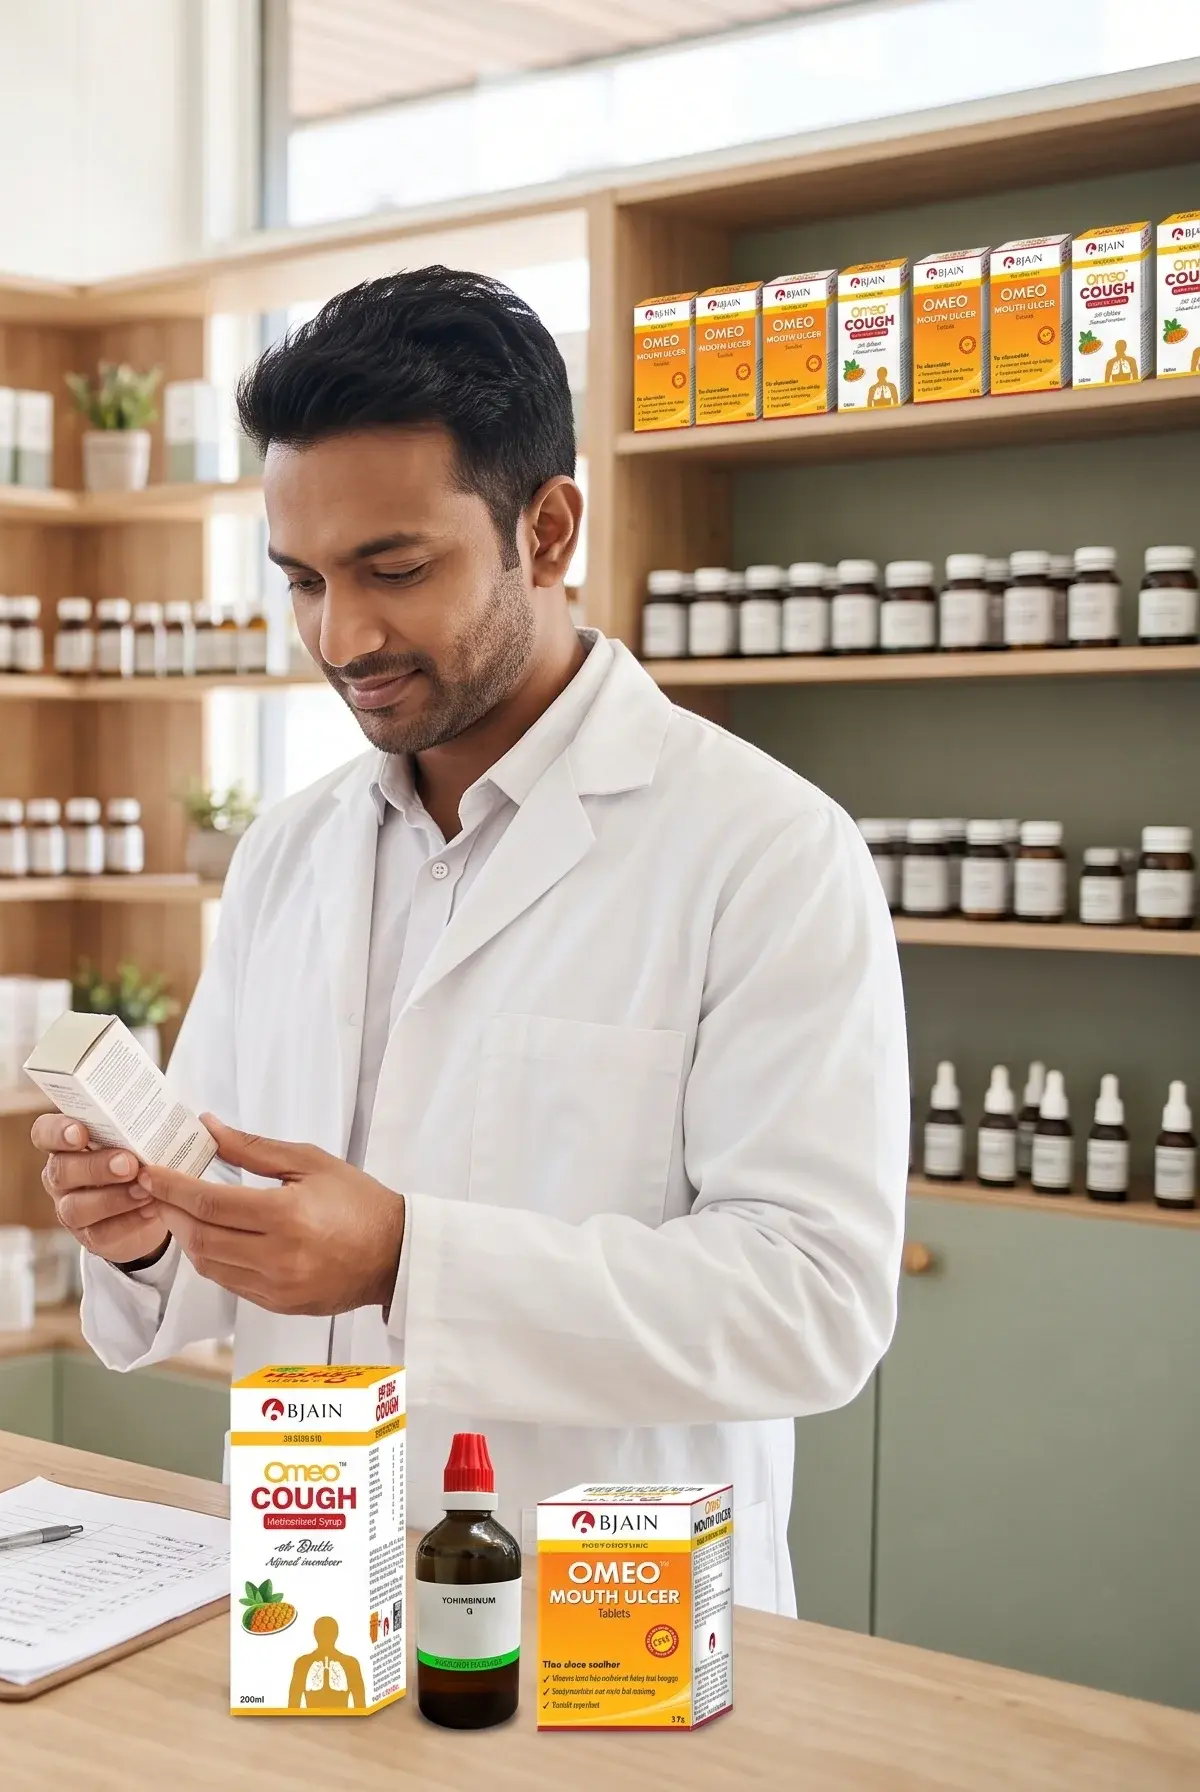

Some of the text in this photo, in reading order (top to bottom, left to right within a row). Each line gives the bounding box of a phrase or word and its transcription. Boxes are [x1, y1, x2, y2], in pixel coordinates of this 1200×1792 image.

[1000, 283, 1047, 301] OMEO
[1080, 281, 1135, 300] COUGH
[923, 295, 968, 312] OMEO
[1027, 299, 1056, 310] ULCER
[844, 314, 895, 331] COUGH
[949, 310, 977, 320] ULCER
[772, 316, 815, 332] OMEO
[704, 325, 745, 341] OMEO
[642, 334, 680, 350] OMEO
[287, 1403, 343, 1422] BJAIN
[263, 1461, 341, 1484] Omeo
[251, 1486, 357, 1510] COUGH
[318, 1517, 343, 1528] Syrup
[600, 1514, 658, 1535] BJAIN
[568, 1561, 661, 1585] OMEO
[441, 1596, 496, 1605] YOHIMBINUM
[549, 1589, 681, 1604] MOUTH ULCER
[598, 1607, 631, 1618] Tablets
[240, 1695, 265, 1704] 200ml
